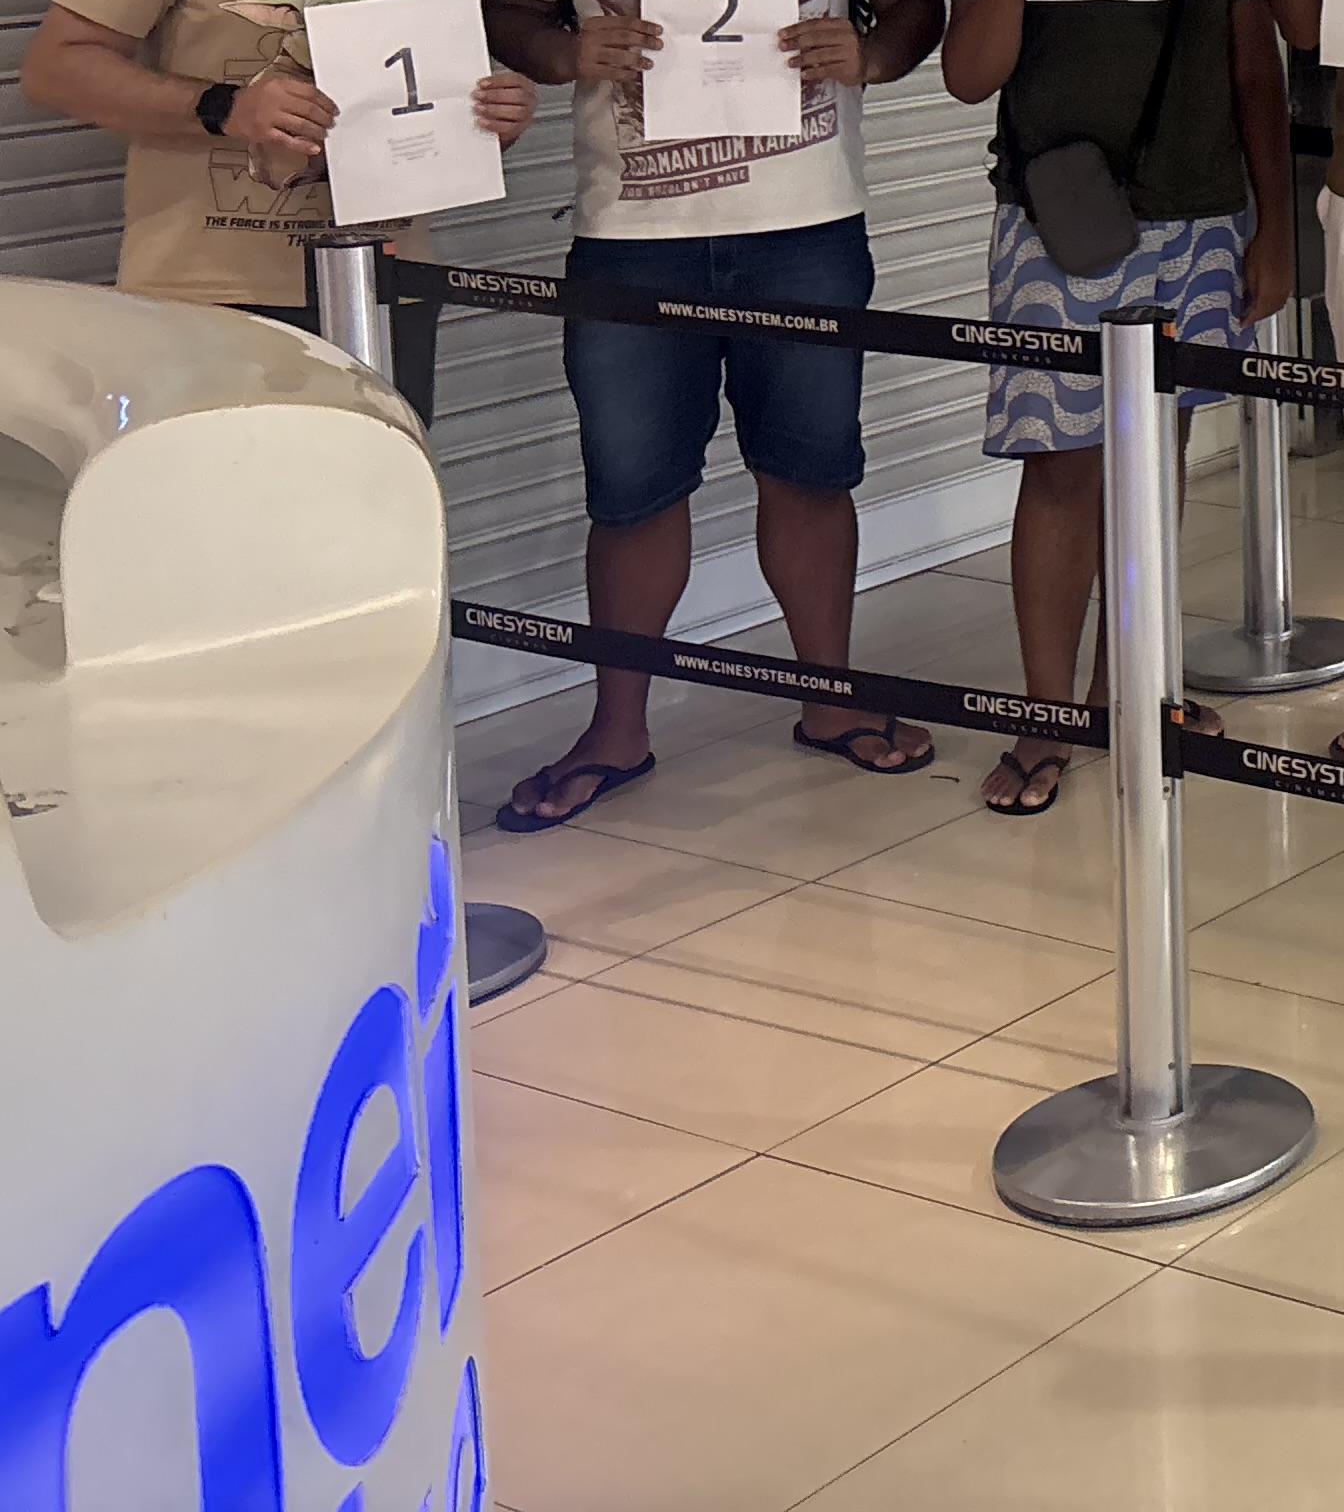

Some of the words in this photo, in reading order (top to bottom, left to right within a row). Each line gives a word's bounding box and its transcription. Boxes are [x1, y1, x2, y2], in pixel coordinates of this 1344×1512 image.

[385, 48, 434, 115] 1
[205, 216, 228, 227] THE
[229, 218, 267, 229] FORCE
[269, 220, 280, 229] IS
[448, 270, 557, 299] CINESYSTEM
[658, 301, 838, 333] WWW.CINESYSTEM.COM.BR
[951, 323, 1083, 355] CINESYSTEM
[465, 607, 573, 645] CINESYSTEM
[673, 653, 853, 695] WWW.CINESYSTEM.COM.BR
[963, 693, 1091, 729] CINESYSTEM
